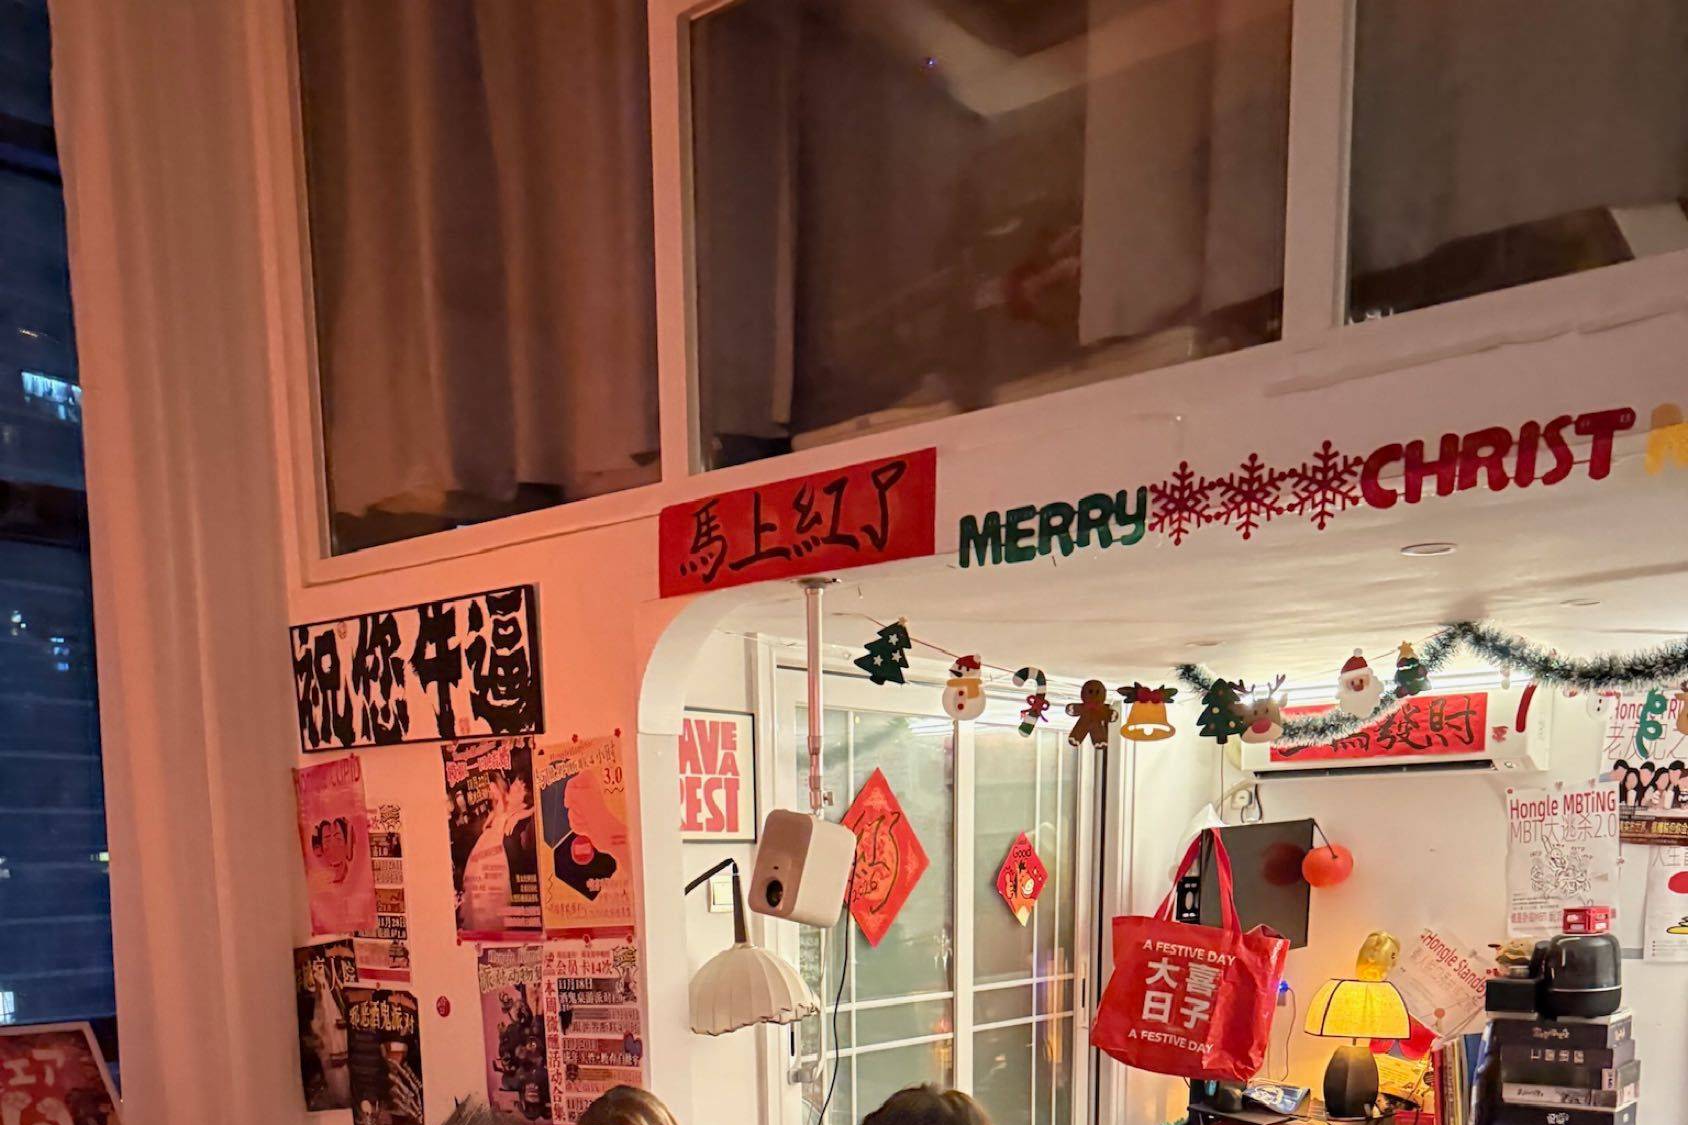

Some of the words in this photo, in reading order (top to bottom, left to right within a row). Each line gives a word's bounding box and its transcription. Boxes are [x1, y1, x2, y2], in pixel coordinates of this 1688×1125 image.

[960, 486, 1148, 568] MERRY
[1360, 407, 1636, 508] CHRIST
[679, 718, 737, 775] AVE
[603, 766, 622, 785] 3.0
[719, 751, 740, 777] A
[680, 776, 740, 833] EST
[1510, 797, 1558, 823] Hongle
[1563, 791, 1616, 816] MBTiNG
[1013, 846, 1032, 858] Good
[1142, 939, 1153, 950] A
[1155, 941, 1205, 960] FESTIVE
[1207, 951, 1236, 966] DAY
[1422, 932, 1458, 967] Hongle
[1453, 959, 1486, 999] Standb
[1128, 1029, 1138, 1039] A
[1140, 1030, 1187, 1048] FESTIVE
[1187, 1040, 1214, 1053] DAY
